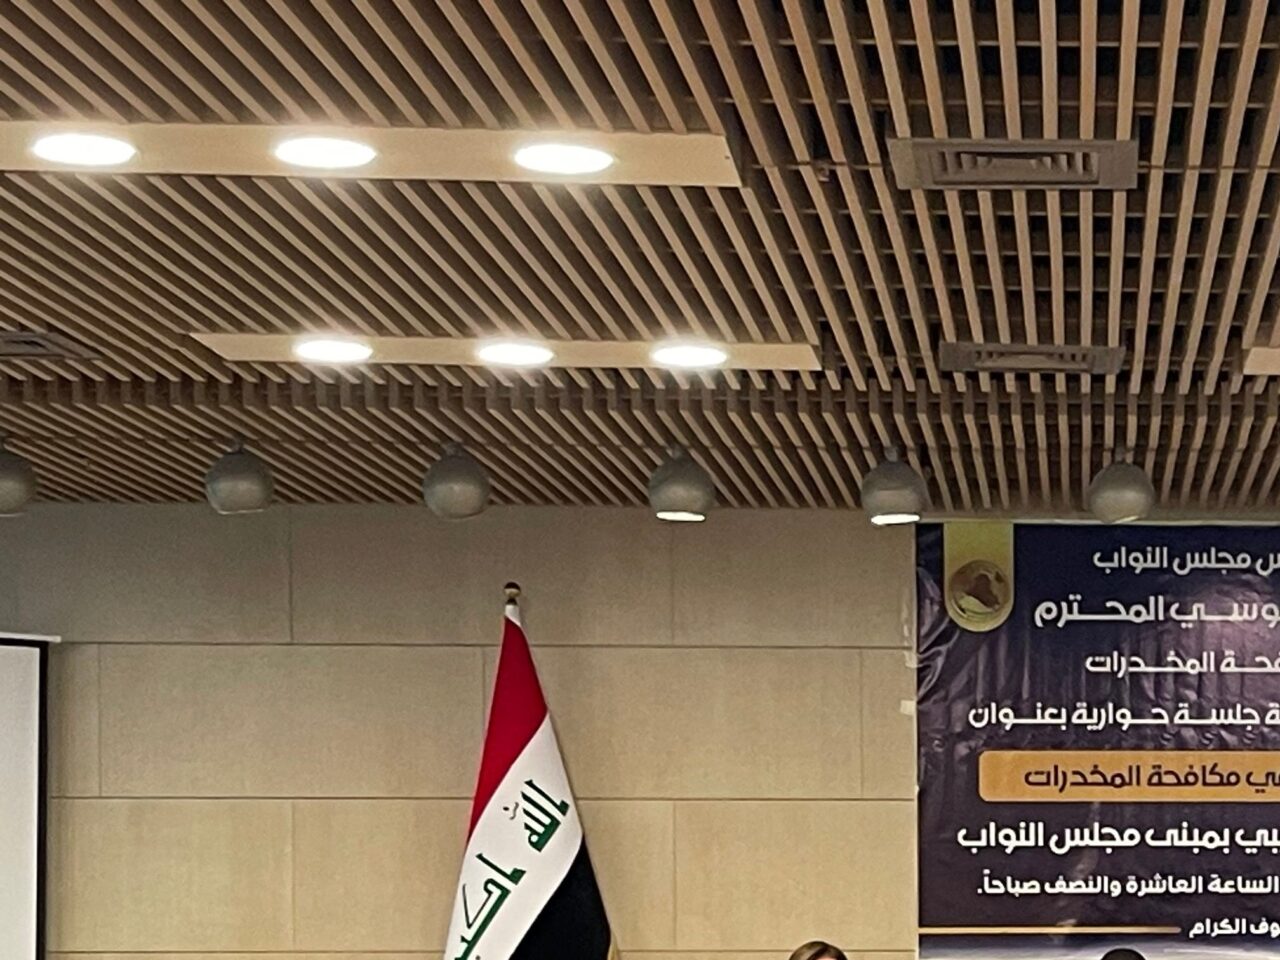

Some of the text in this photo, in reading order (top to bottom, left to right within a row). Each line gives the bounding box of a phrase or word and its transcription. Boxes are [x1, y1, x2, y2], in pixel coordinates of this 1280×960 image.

[1093, 546, 1168, 574] النواب
[1172, 547, 1252, 575] مجلس
[1034, 594, 1165, 628] المحترم
[1085, 650, 1215, 678] المخدرات
[967, 702, 1067, 730] بعنوان
[1070, 702, 1169, 730] حوارية
[1173, 702, 1260, 730] جلسة
[1024, 764, 1141, 793] المخدرات
[1146, 762, 1241, 787] مكافحة
[956, 821, 1045, 854] النواب
[1049, 821, 1142, 855] مجلس
[1144, 821, 1230, 854] بمبنى
[1044, 875, 1122, 897] والنصف
[1125, 873, 1203, 897] العاشرة
[1207, 874, 1280, 894] الساعة
[1188, 917, 1247, 938] الكرام
